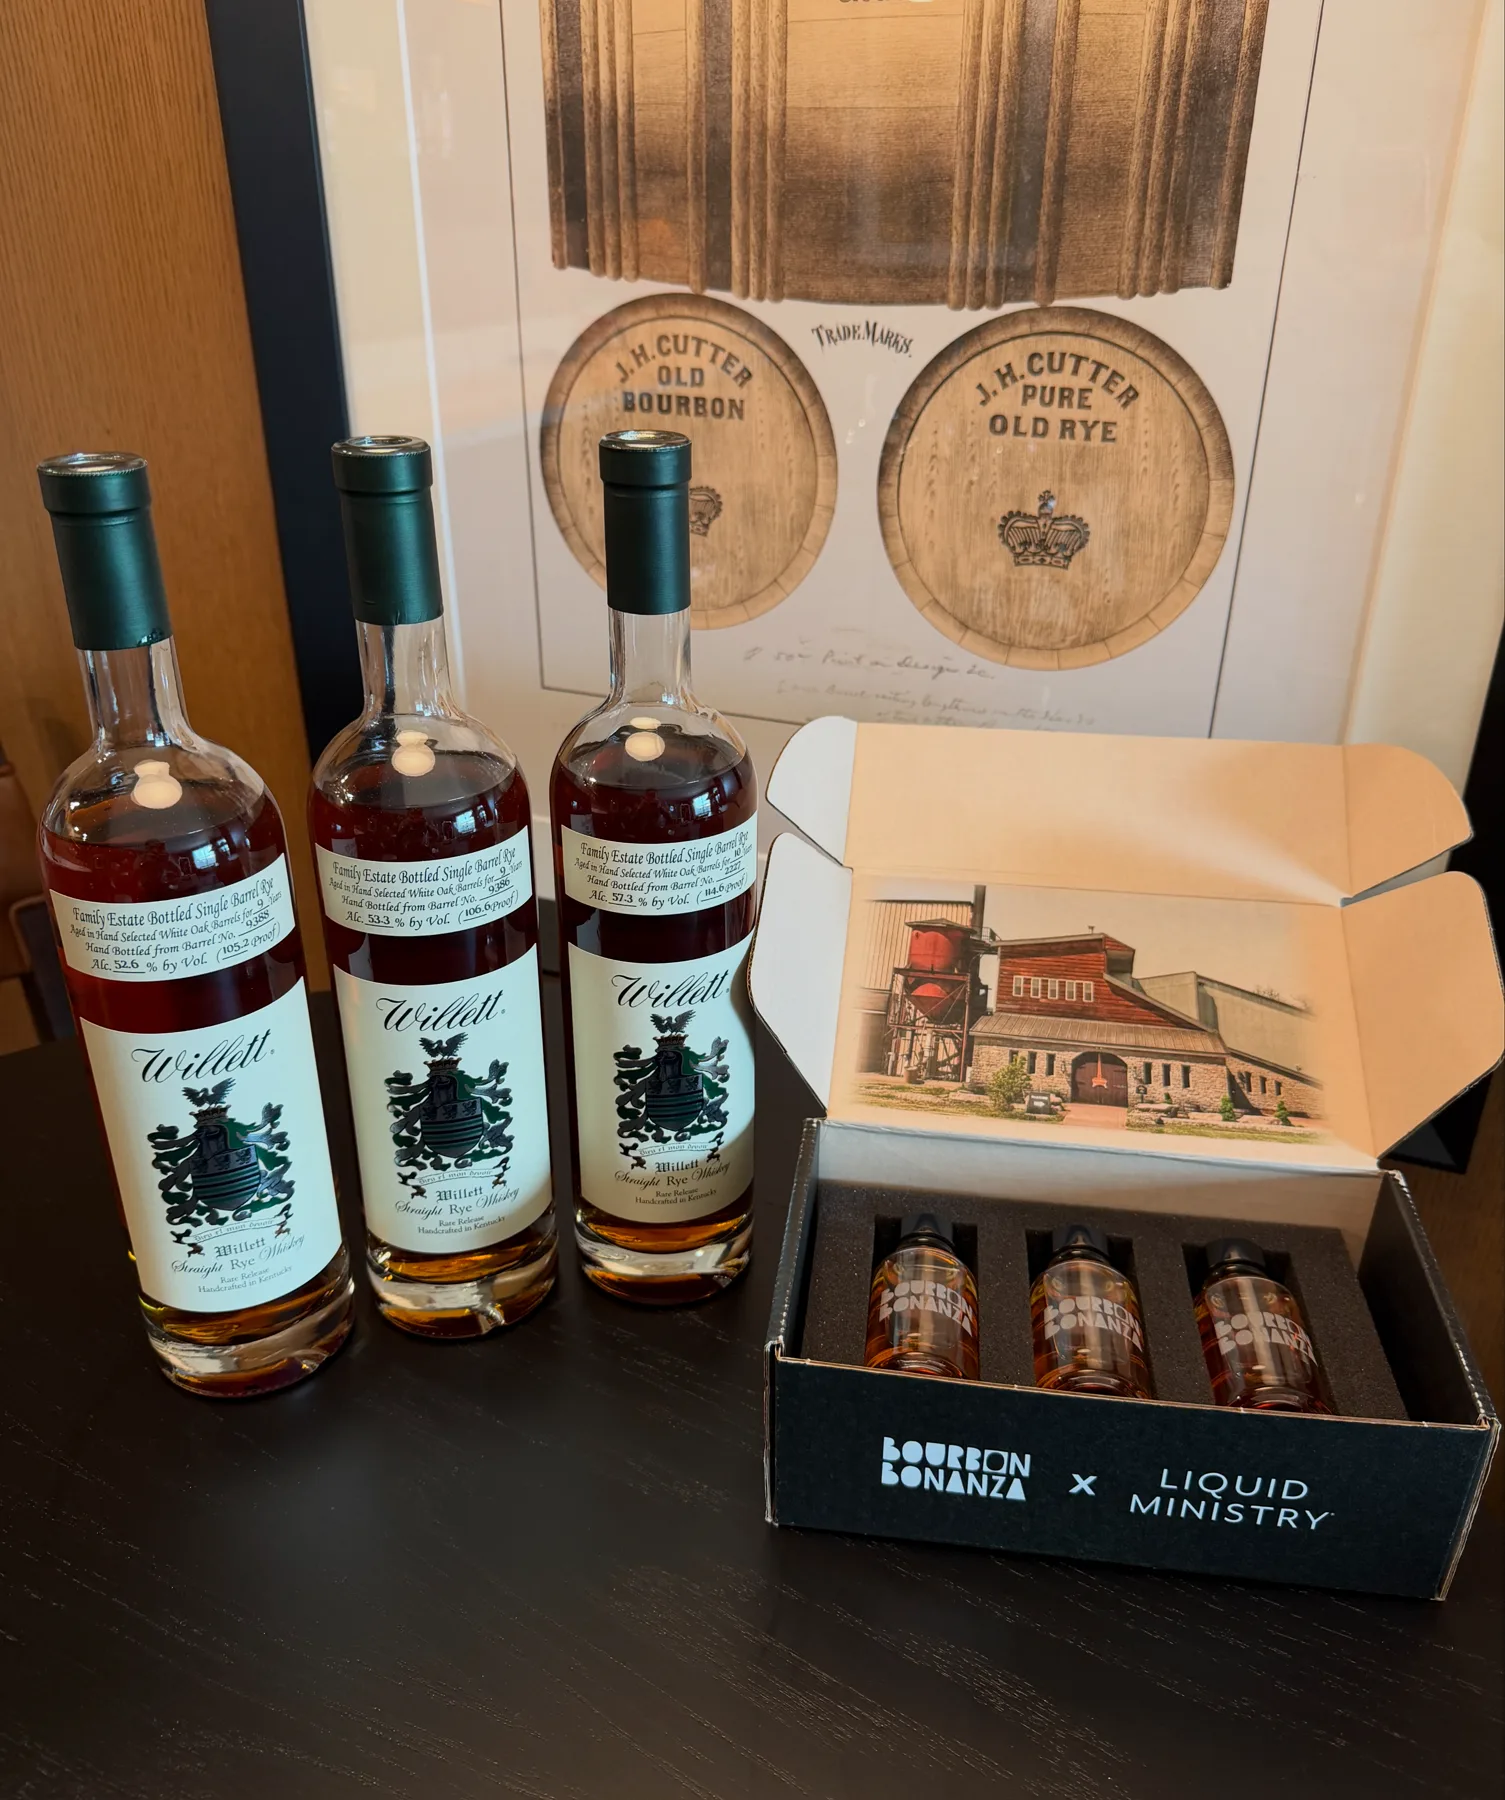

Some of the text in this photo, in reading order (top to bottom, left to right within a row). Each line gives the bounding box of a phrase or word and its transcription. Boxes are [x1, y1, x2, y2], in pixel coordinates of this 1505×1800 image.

[658, 365, 705, 388] OLD
[622, 391, 745, 421] BOURBON
[1021, 384, 1093, 410] PURE
[989, 414, 1118, 443] OLD RYE
[574, 858, 589, 870] Aged
[590, 862, 598, 872] in
[598, 865, 620, 877] Hand
[620, 868, 653, 879] Selected
[653, 867, 678, 879] White
[680, 865, 697, 877] Oak
[696, 859, 721, 874] Barrels
[720, 856, 731, 870] for
[734, 848, 741, 858] 10
[581, 842, 610, 865] Family
[611, 849, 644, 865] Estate
[646, 847, 686, 865] Bottled
[685, 842, 713, 864] Single
[714, 832, 739, 855] Barrel
[332, 847, 516, 885] Family Estate Bottled Single Barrel Rye
[329, 877, 343, 891] Aged
[343, 882, 351, 892] in
[351, 884, 373, 896] Hand
[373, 888, 407, 898] Selected
[408, 887, 435, 898] White
[436, 883, 456, 896] Oak
[455, 876, 483, 893] Barrels
[483, 874, 495, 889] for
[499, 866, 506, 877] 9
[341, 878, 511, 915] Hand Bottled from Barrel No. 9386
[586, 874, 610, 887] Hand
[610, 880, 646, 892] Bottled
[644, 882, 668, 894] from
[670, 876, 699, 891] Barrel
[700, 875, 714, 887] No.
[72, 878, 274, 930] Family Estate Bottled Single Barrel Rye
[588, 890, 608, 902] Alc.
[612, 892, 634, 903] 57.3
[638, 897, 648, 907] %
[651, 896, 665, 910] by
[667, 893, 690, 906] Vol.
[70, 924, 86, 938] Aged
[87, 928, 95, 938] in
[95, 930, 119, 942] Hand
[120, 929, 157, 942] Selected
[159, 927, 188, 939] White
[190, 920, 212, 935] Oak
[211, 911, 241, 930] Barrels
[240, 908, 253, 924] for
[257, 898, 264, 908] 9
[345, 910, 364, 924] Alc.
[367, 914, 391, 925] 53.3
[394, 917, 405, 928] %
[409, 917, 423, 931] by
[426, 913, 450, 926] Vol.
[85, 942, 111, 955] Hand
[111, 944, 152, 956] Bottled
[151, 944, 179, 958] from
[181, 933, 217, 951] Barrel
[218, 931, 236, 944] No.
[91, 959, 112, 971] Alc.
[114, 959, 140, 970] 52.6
[146, 962, 158, 972] %
[163, 959, 178, 974] by
[181, 952, 208, 968] Vol.
[611, 969, 729, 1009] Willett
[375, 990, 503, 1033] Willett
[131, 1028, 271, 1084] Willett
[614, 1161, 731, 1190] Straight Rye Whiskey
[655, 1159, 699, 1174] Willett
[395, 1185, 520, 1220] Straight Rye Whiskey
[436, 1186, 483, 1203] Willett
[635, 1196, 678, 1205] Handcrafted
[673, 1188, 699, 1197] Release
[417, 1226, 463, 1234] Handcrafted
[473, 1216, 506, 1230] Kentucky
[458, 1216, 485, 1225] Release
[171, 1233, 305, 1279] Straight Rye Whiskey
[214, 1237, 266, 1259] Willett
[198, 1266, 293, 1293] Handcrafted in Kentucky
[220, 1267, 270, 1284] Rare Release
[879, 1295, 973, 1338] BONANZA
[880, 1280, 973, 1324] BOURBON
[1043, 1295, 1141, 1336] BOURBON
[1044, 1312, 1143, 1353] BONANZA
[882, 1435, 1031, 1478] BOURBON
[880, 1461, 1026, 1501] BONANZA
[1159, 1468, 1309, 1501] LIQUID
[1129, 1493, 1331, 1531] MINISTRY
